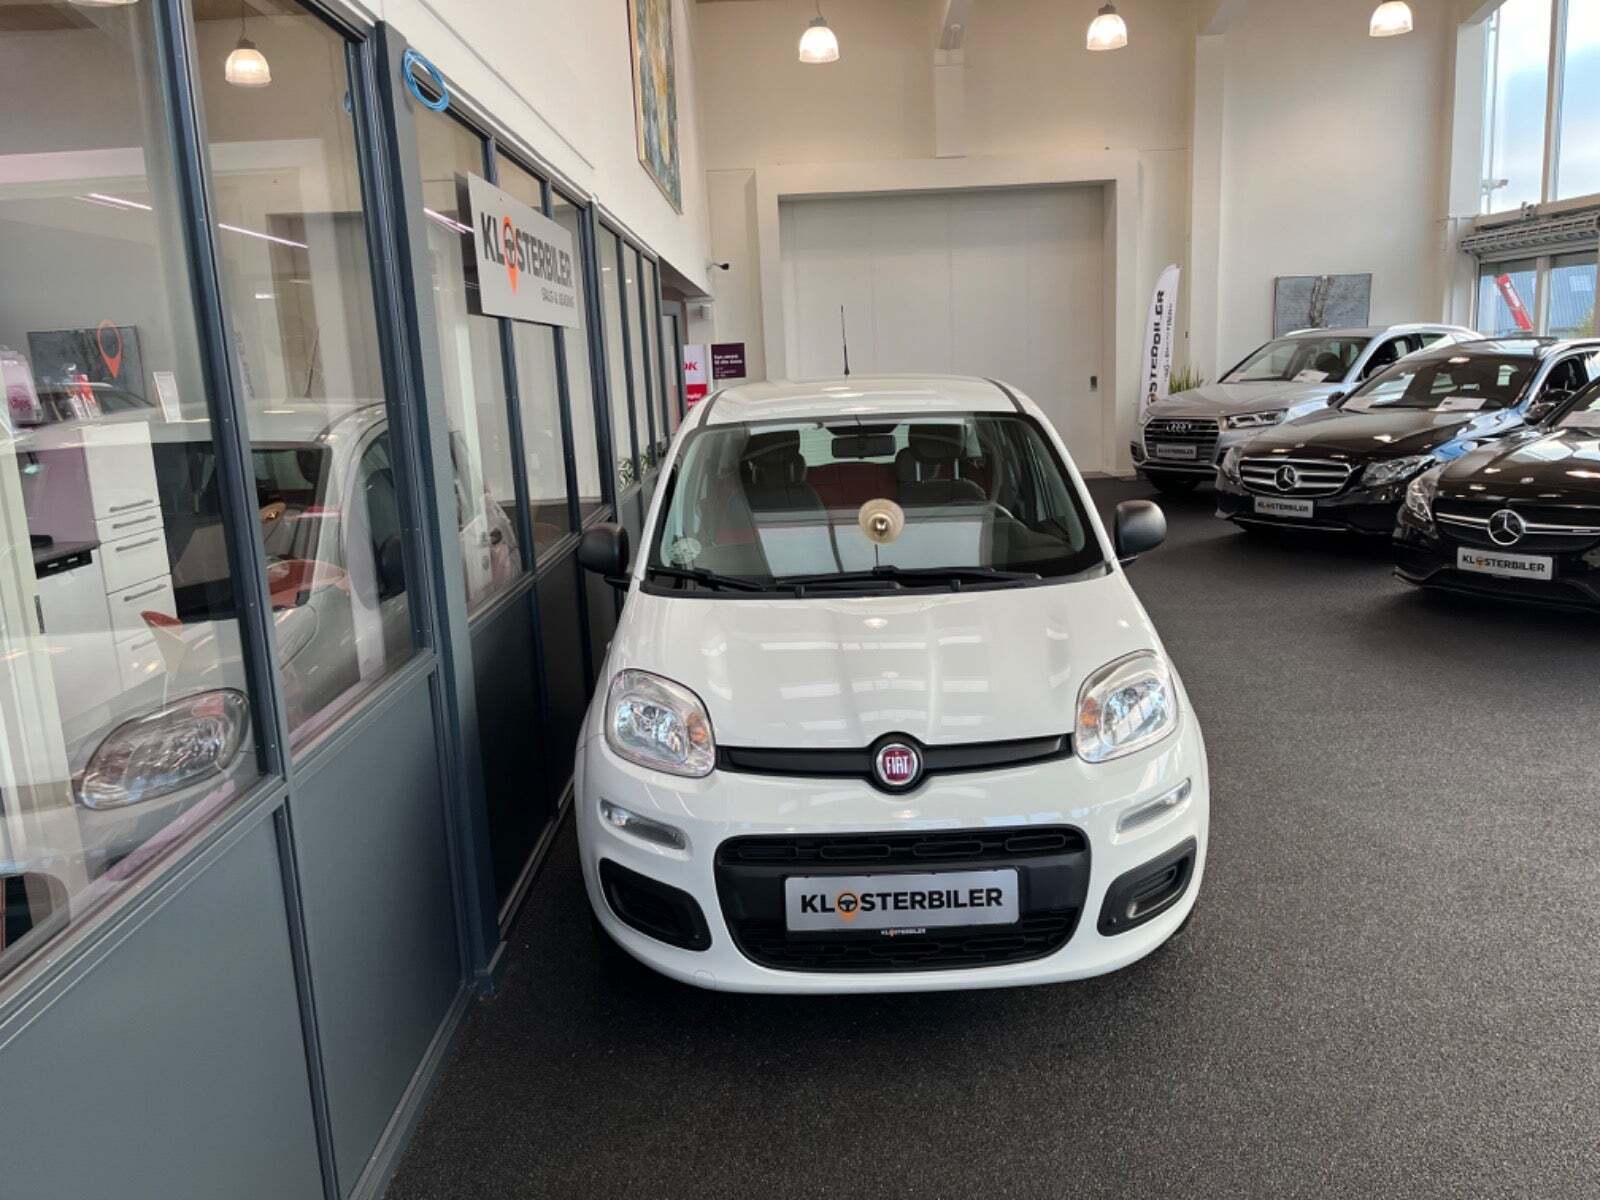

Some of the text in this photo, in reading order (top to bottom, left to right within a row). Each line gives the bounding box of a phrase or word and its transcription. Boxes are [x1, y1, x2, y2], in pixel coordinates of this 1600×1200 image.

[1462, 554, 1545, 572] KLOSTERBILER
[885, 756, 908, 775] FIAT
[801, 888, 1003, 913] KLOSTERBILER
